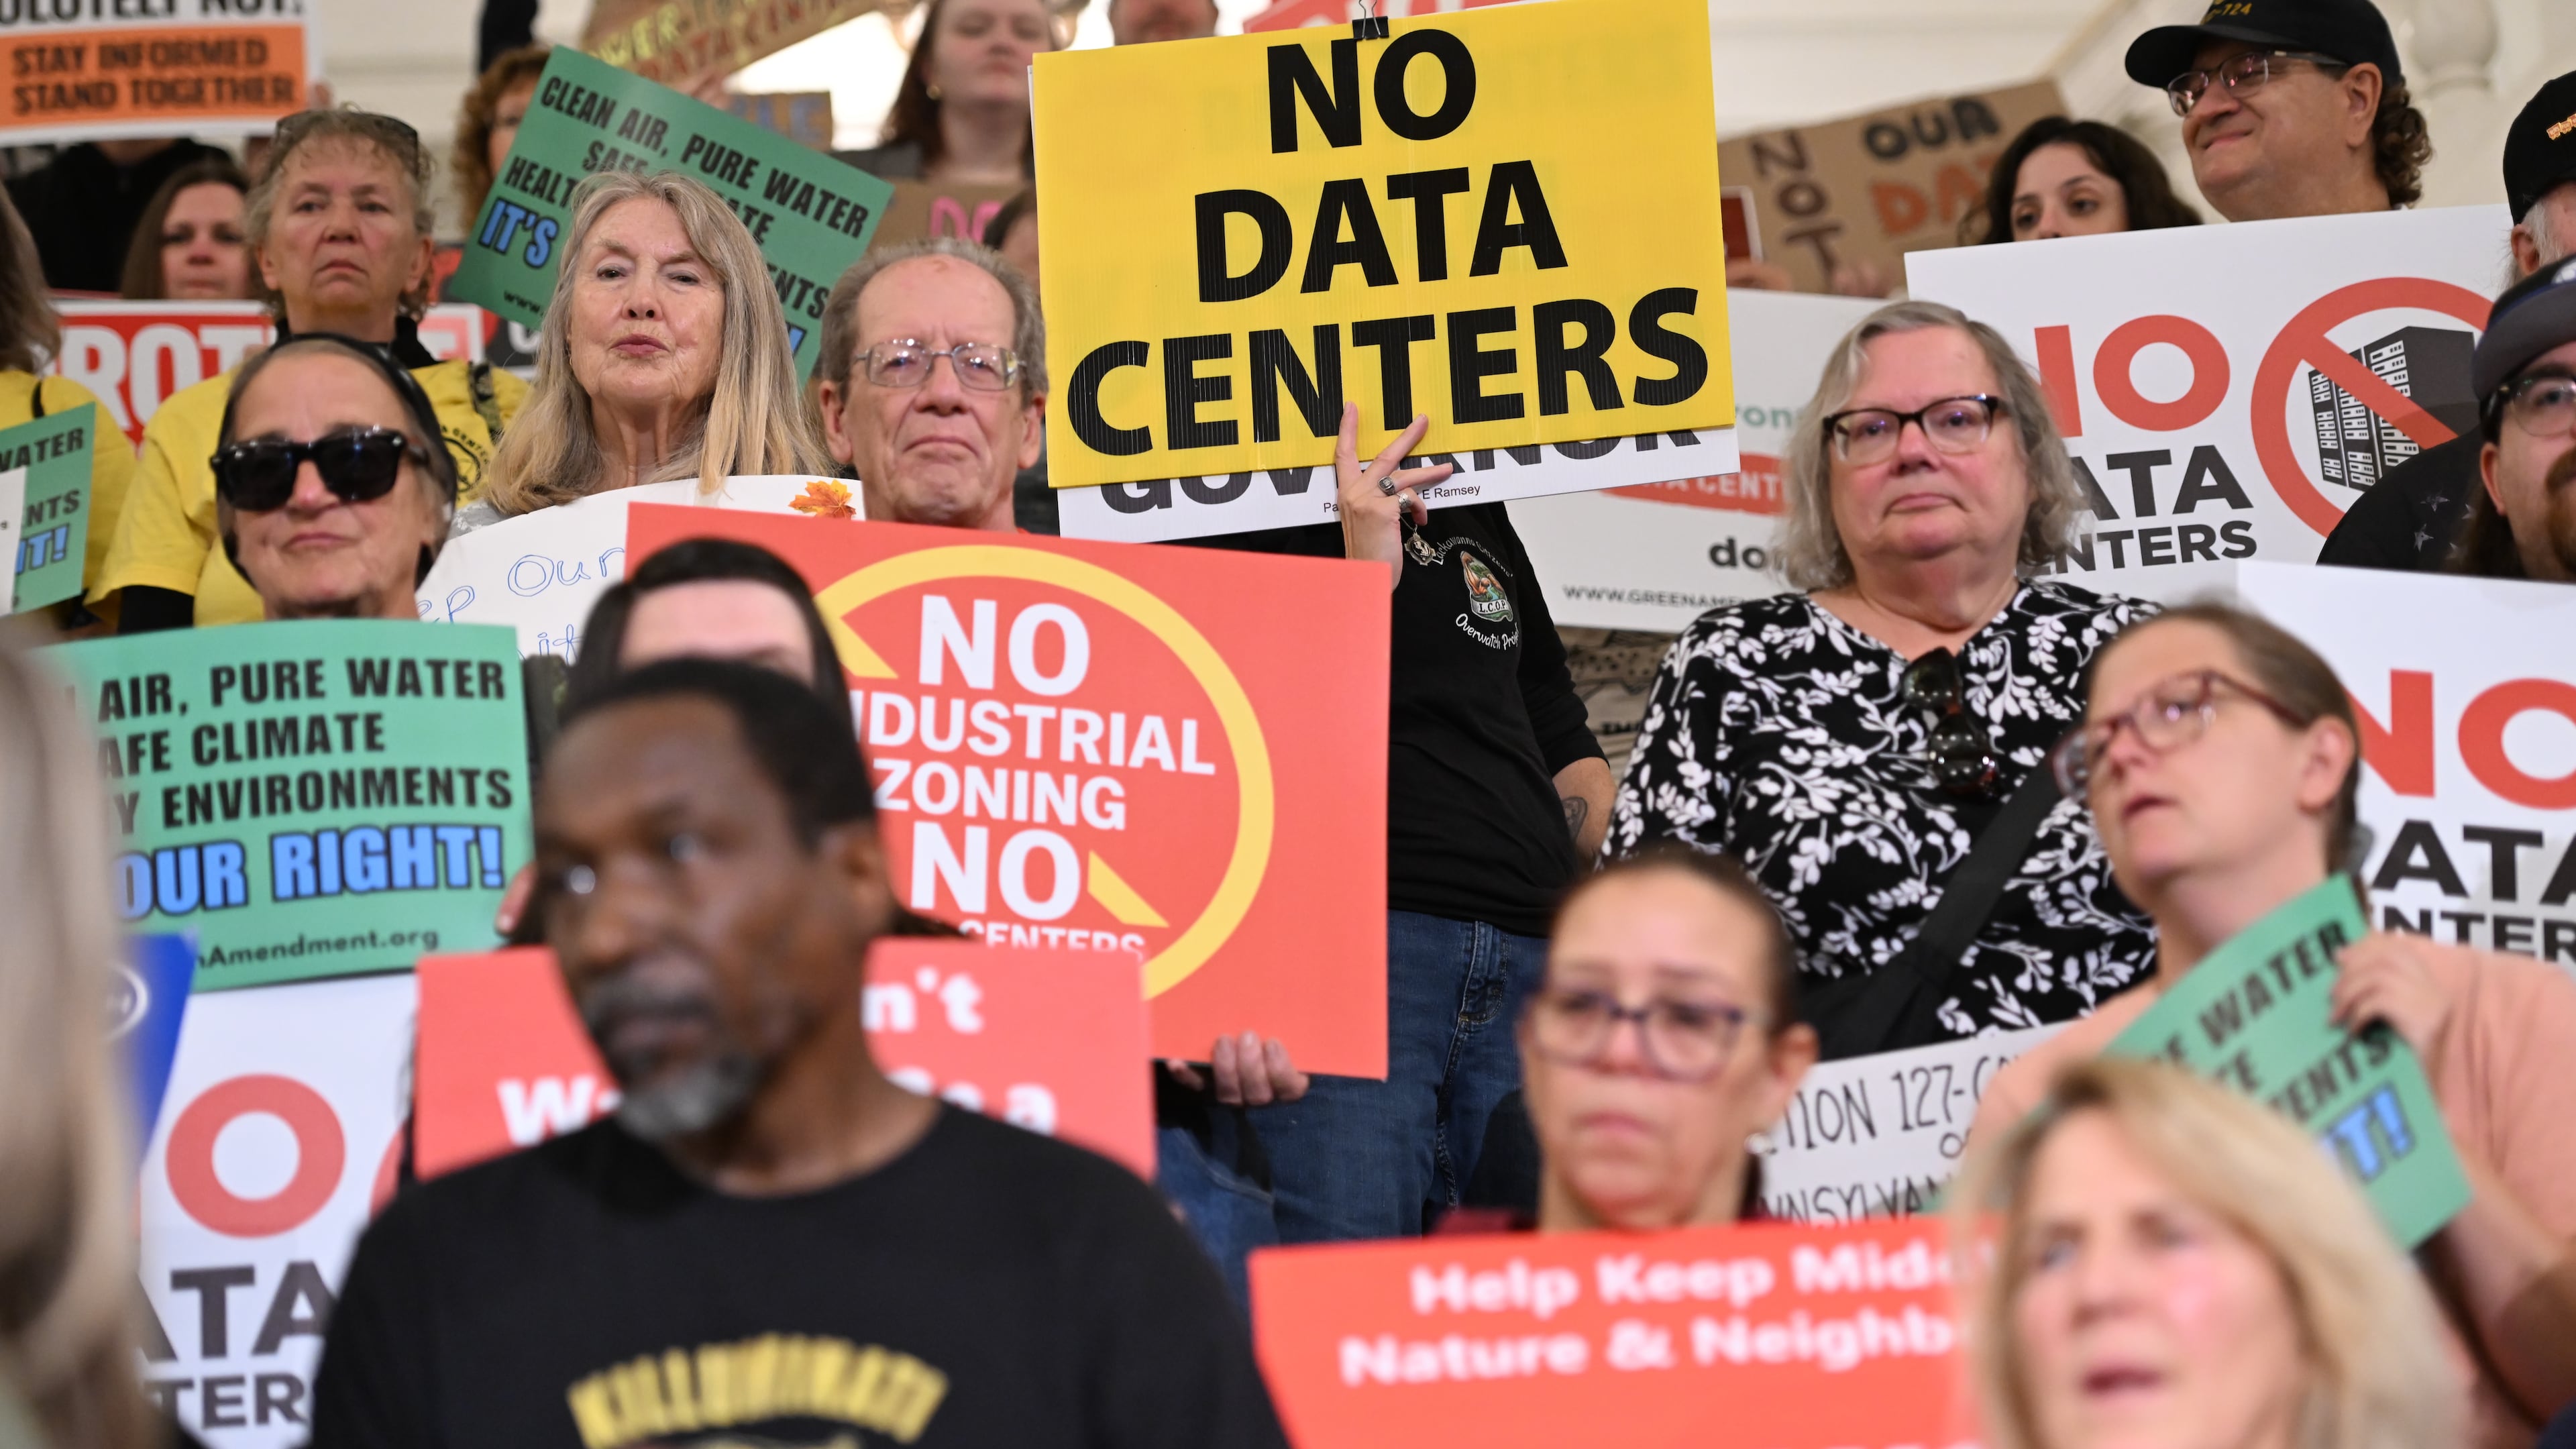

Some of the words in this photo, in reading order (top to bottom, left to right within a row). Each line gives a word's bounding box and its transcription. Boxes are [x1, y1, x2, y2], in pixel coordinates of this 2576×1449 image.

[12, 44, 85, 77] STAY
[98, 39, 269, 68] INFORMED
[1267, 29, 1477, 154] NO
[12, 81, 117, 115] STAND
[130, 72, 294, 107] TOGETHER
[541, 76, 618, 129] CLEAN
[616, 107, 669, 158] AIR,
[680, 133, 760, 191] PURE
[763, 167, 870, 241] WATER
[1864, 98, 2002, 162] OUR
[478, 195, 559, 269] IT'S
[1195, 160, 1568, 303] DATA
[1748, 129, 1843, 290] NOT
[1067, 286, 1709, 456] CENTERS
[1423, 489, 1431, 499] E
[1434, 484, 1481, 502] Ramsey
[507, 547, 625, 597] Our
[1432, 535, 1476, 566] Lackawanna
[918, 594, 1091, 697] NO
[1455, 612, 1501, 650] Overwatch
[98, 674, 188, 724] AIR,
[210, 658, 326, 708] PURE
[346, 657, 507, 701] WATER
[191, 711, 386, 768] CLIMATE
[162, 766, 513, 830] ENVIRONMENTS
[873, 759, 1126, 831] ZONING
[270, 823, 504, 902] RIGHT!
[910, 820, 1081, 922] NO
[2198, 919, 2349, 1046] WATER
[1409, 1257, 1580, 1320] Help
[1595, 1250, 1774, 1308] Keep
[1339, 1330, 1591, 1389] Nature
[1606, 1319, 1674, 1371] &
